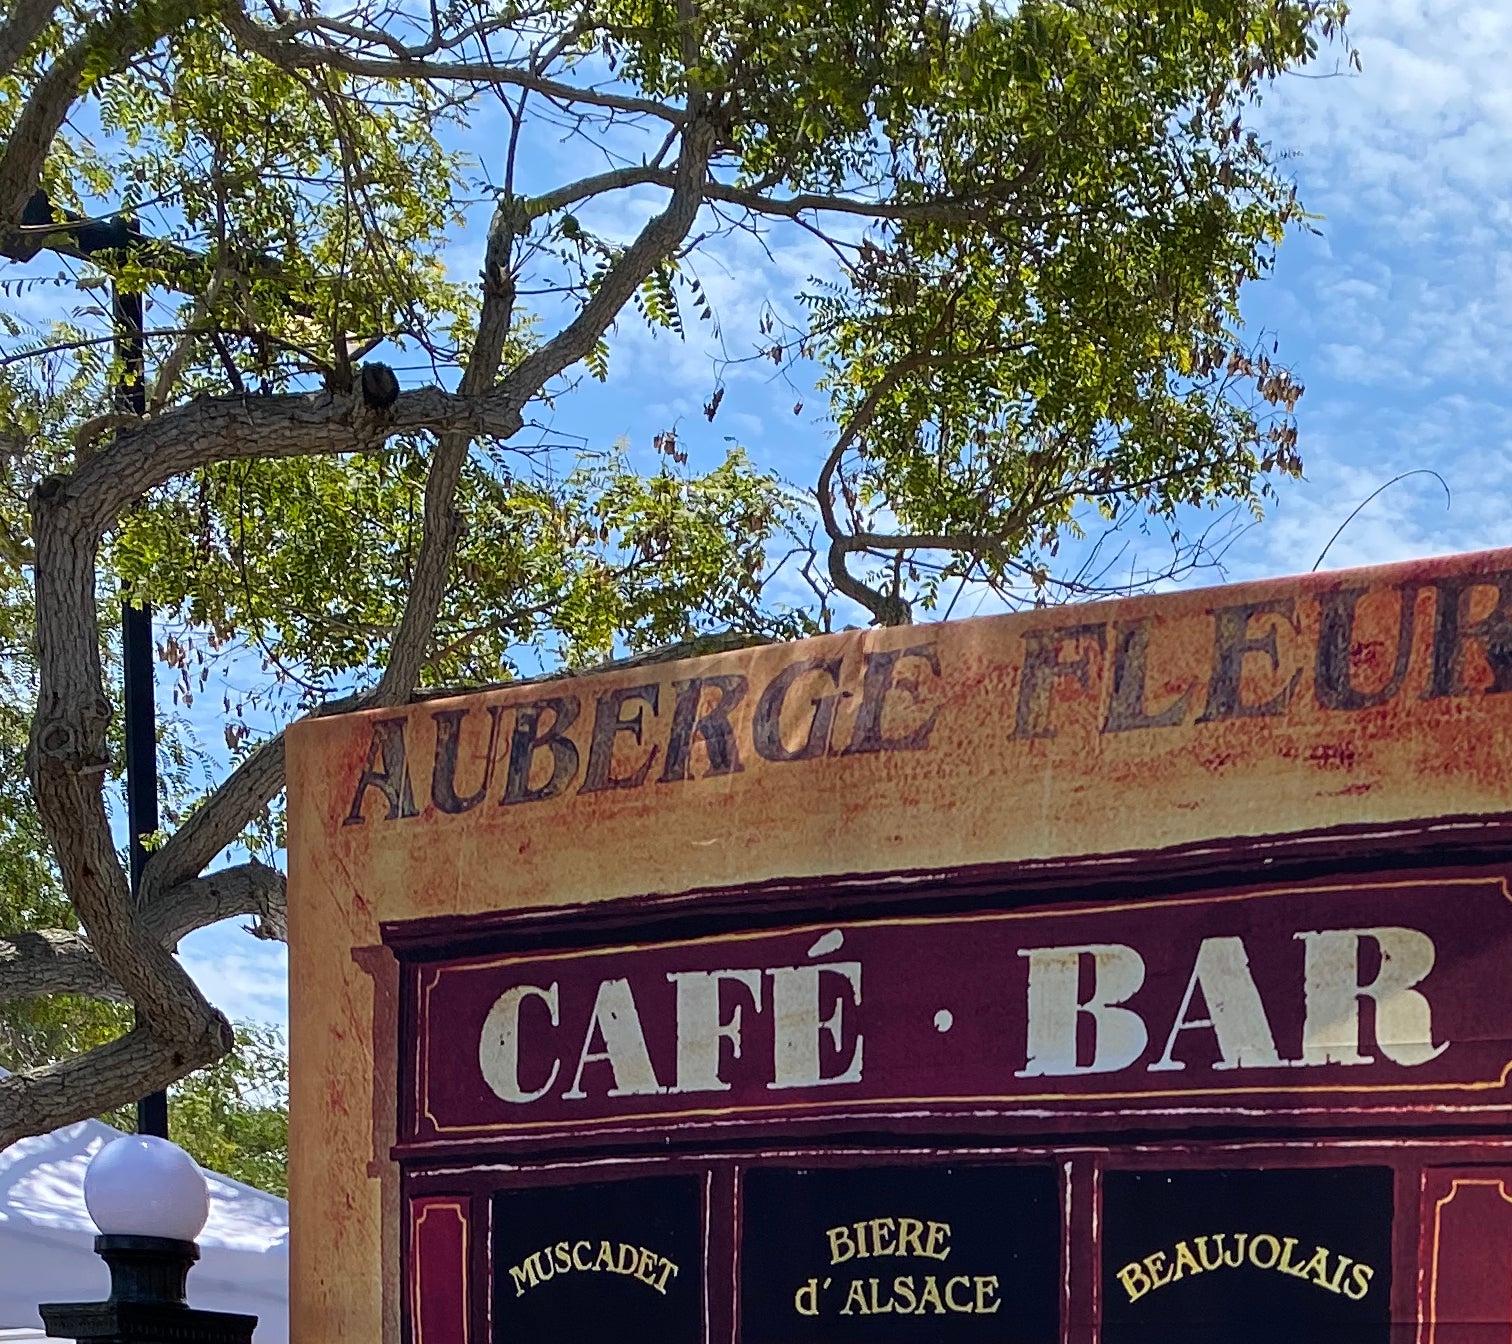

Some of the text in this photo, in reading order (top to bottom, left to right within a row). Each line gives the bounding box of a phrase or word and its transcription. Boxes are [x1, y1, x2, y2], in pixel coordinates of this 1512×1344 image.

[342, 641, 942, 826] AUBERGE
[478, 926, 1451, 1104] CAFÉ BAR
[508, 1240, 679, 1298] MUSCADET
[826, 1217, 952, 1265] BIERE
[1116, 1233, 1374, 1303] BEAUJOLAIS
